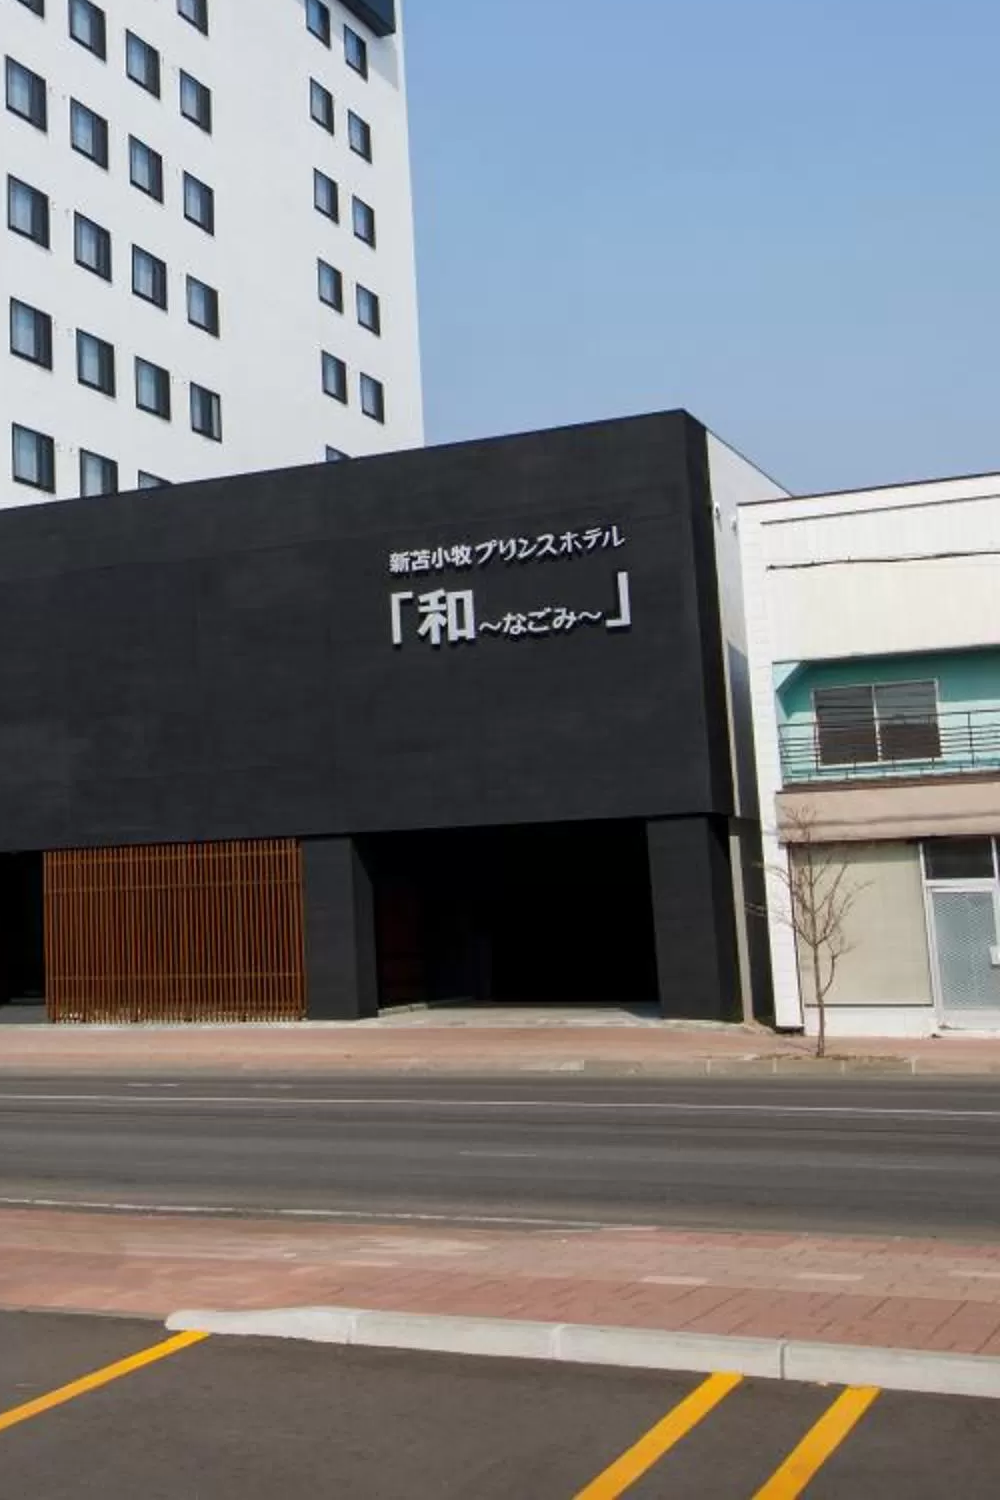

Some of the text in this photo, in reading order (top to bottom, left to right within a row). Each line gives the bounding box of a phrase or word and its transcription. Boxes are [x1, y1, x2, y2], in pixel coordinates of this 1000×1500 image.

[389, 525, 625, 572] 新苫小牧プリンスホテル
